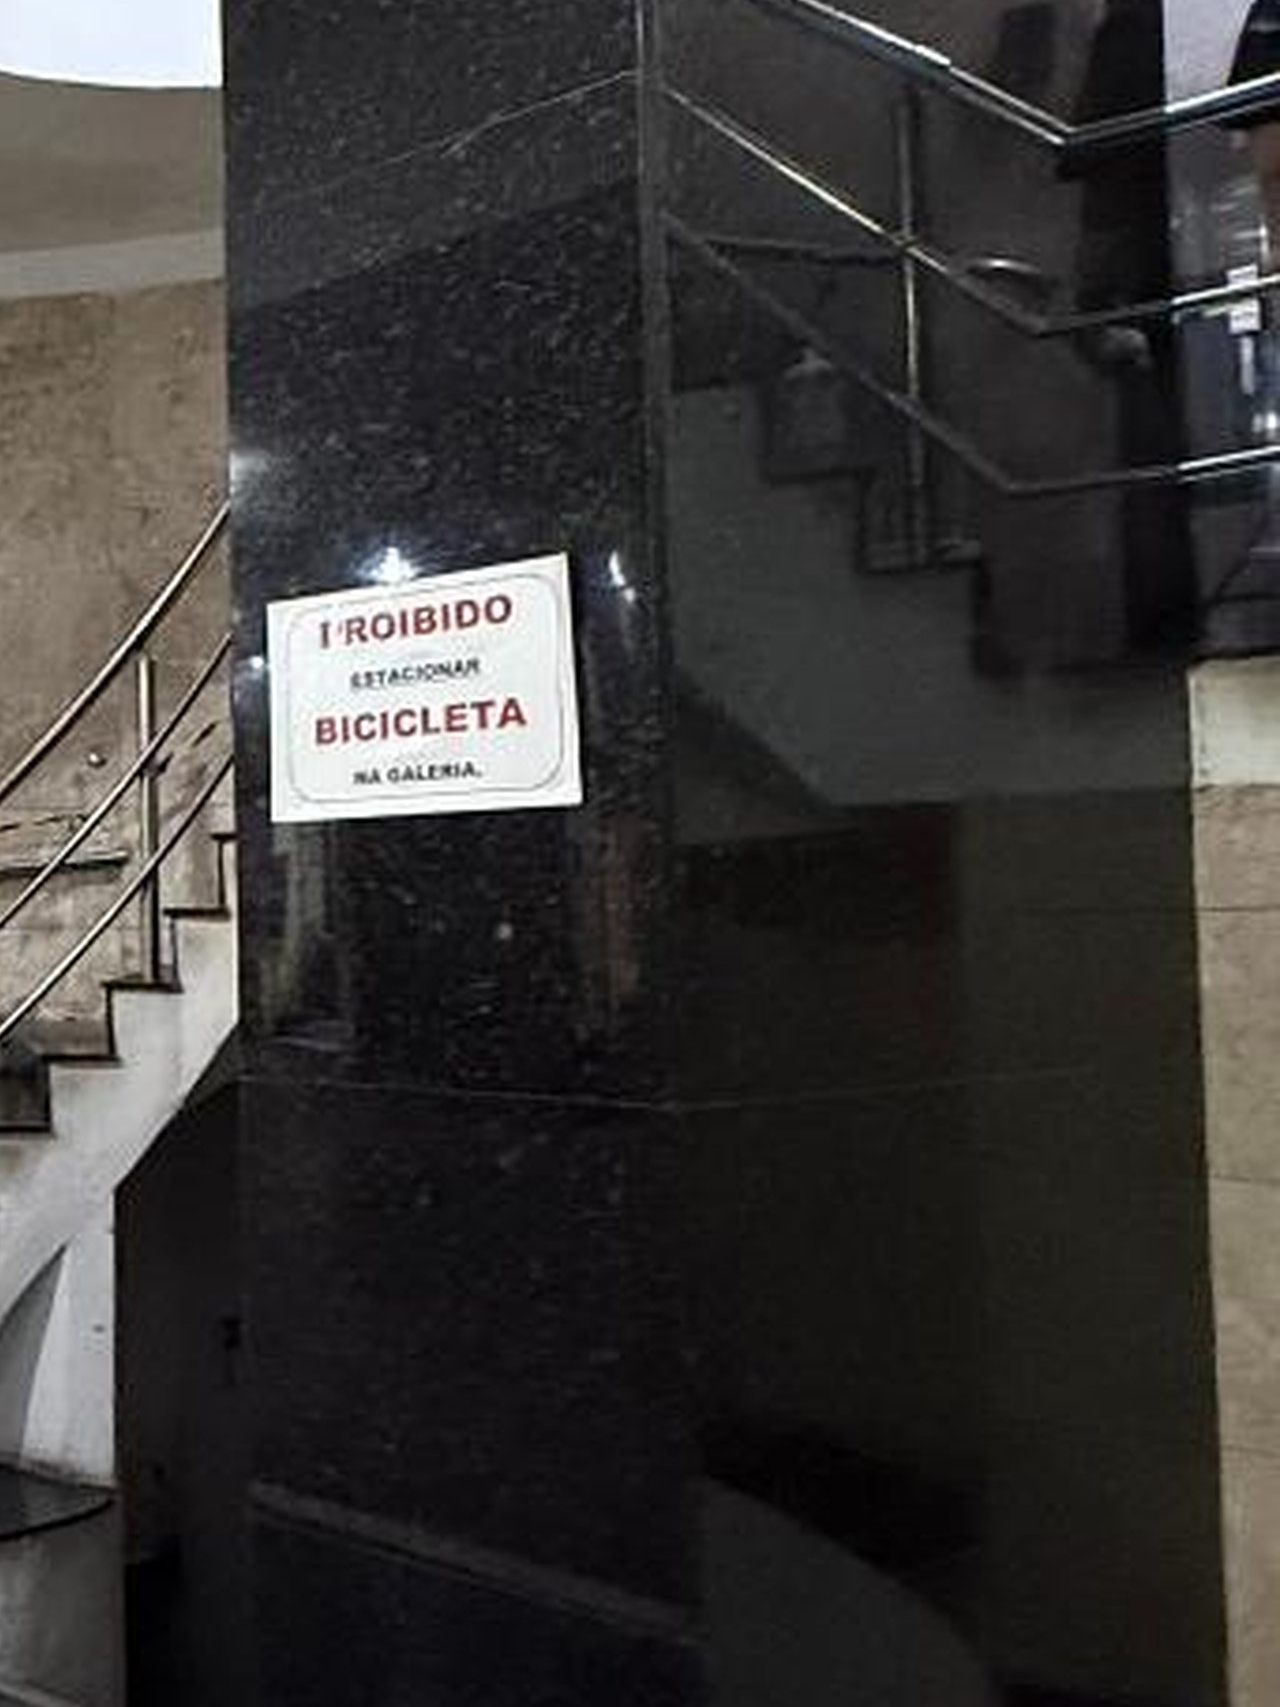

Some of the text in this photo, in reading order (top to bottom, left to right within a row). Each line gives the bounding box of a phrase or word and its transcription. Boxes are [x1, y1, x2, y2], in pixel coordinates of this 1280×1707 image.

[351, 658, 481, 690] ESTACIONAR
[314, 697, 527, 746] BICICLETA
[353, 769, 381, 785] NA
